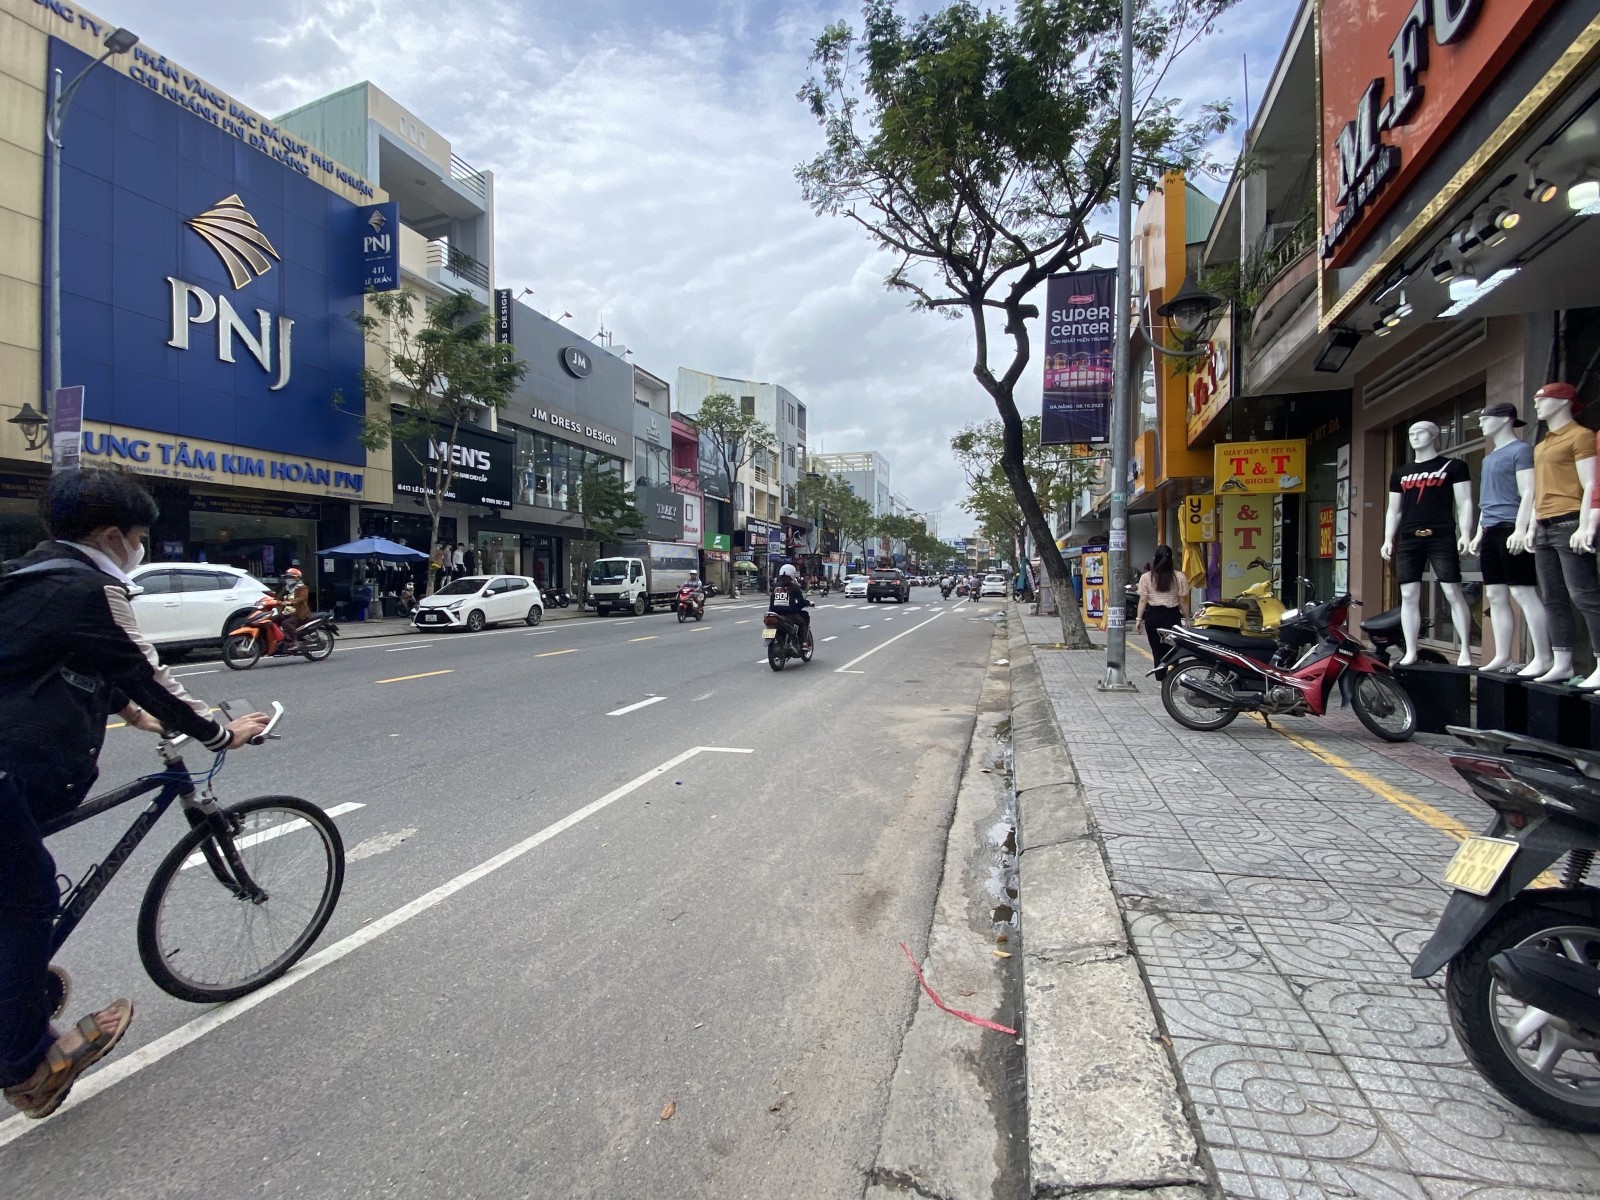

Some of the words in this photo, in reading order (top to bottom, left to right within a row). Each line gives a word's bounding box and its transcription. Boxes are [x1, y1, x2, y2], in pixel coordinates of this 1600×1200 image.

[78, 14, 104, 37] TY
[129, 65, 159, 91] CHI
[162, 83, 219, 125] NHÁNH
[223, 116, 246, 140] PNJ
[184, 75, 226, 111] VÀNG
[229, 102, 257, 130] BẠC
[281, 134, 309, 159] QUÝ
[311, 151, 334, 174] PHÚ
[336, 166, 374, 199] NHUẬN
[363, 234, 391, 255] PNJ
[371, 265, 385, 275] 411
[167, 276, 296, 391] PNJ
[501, 332, 509, 364] DSS
[573, 352, 587, 370] JM
[531, 407, 548, 422] JM
[551, 413, 582, 433] DRESS
[585, 426, 617, 446] DESIGN
[428, 438, 491, 471] MEN'S
[1230, 457, 1249, 477] T
[1252, 461, 1268, 476] &
[1271, 455, 1291, 475] T
[157, 441, 216, 472] TÂM
[222, 453, 266, 478] KIM
[270, 460, 331, 487] HOÀN
[334, 470, 364, 493] PNJ
[1245, 477, 1275, 485] SHOES
[1236, 504, 1259, 521] &
[1233, 527, 1262, 550] T
